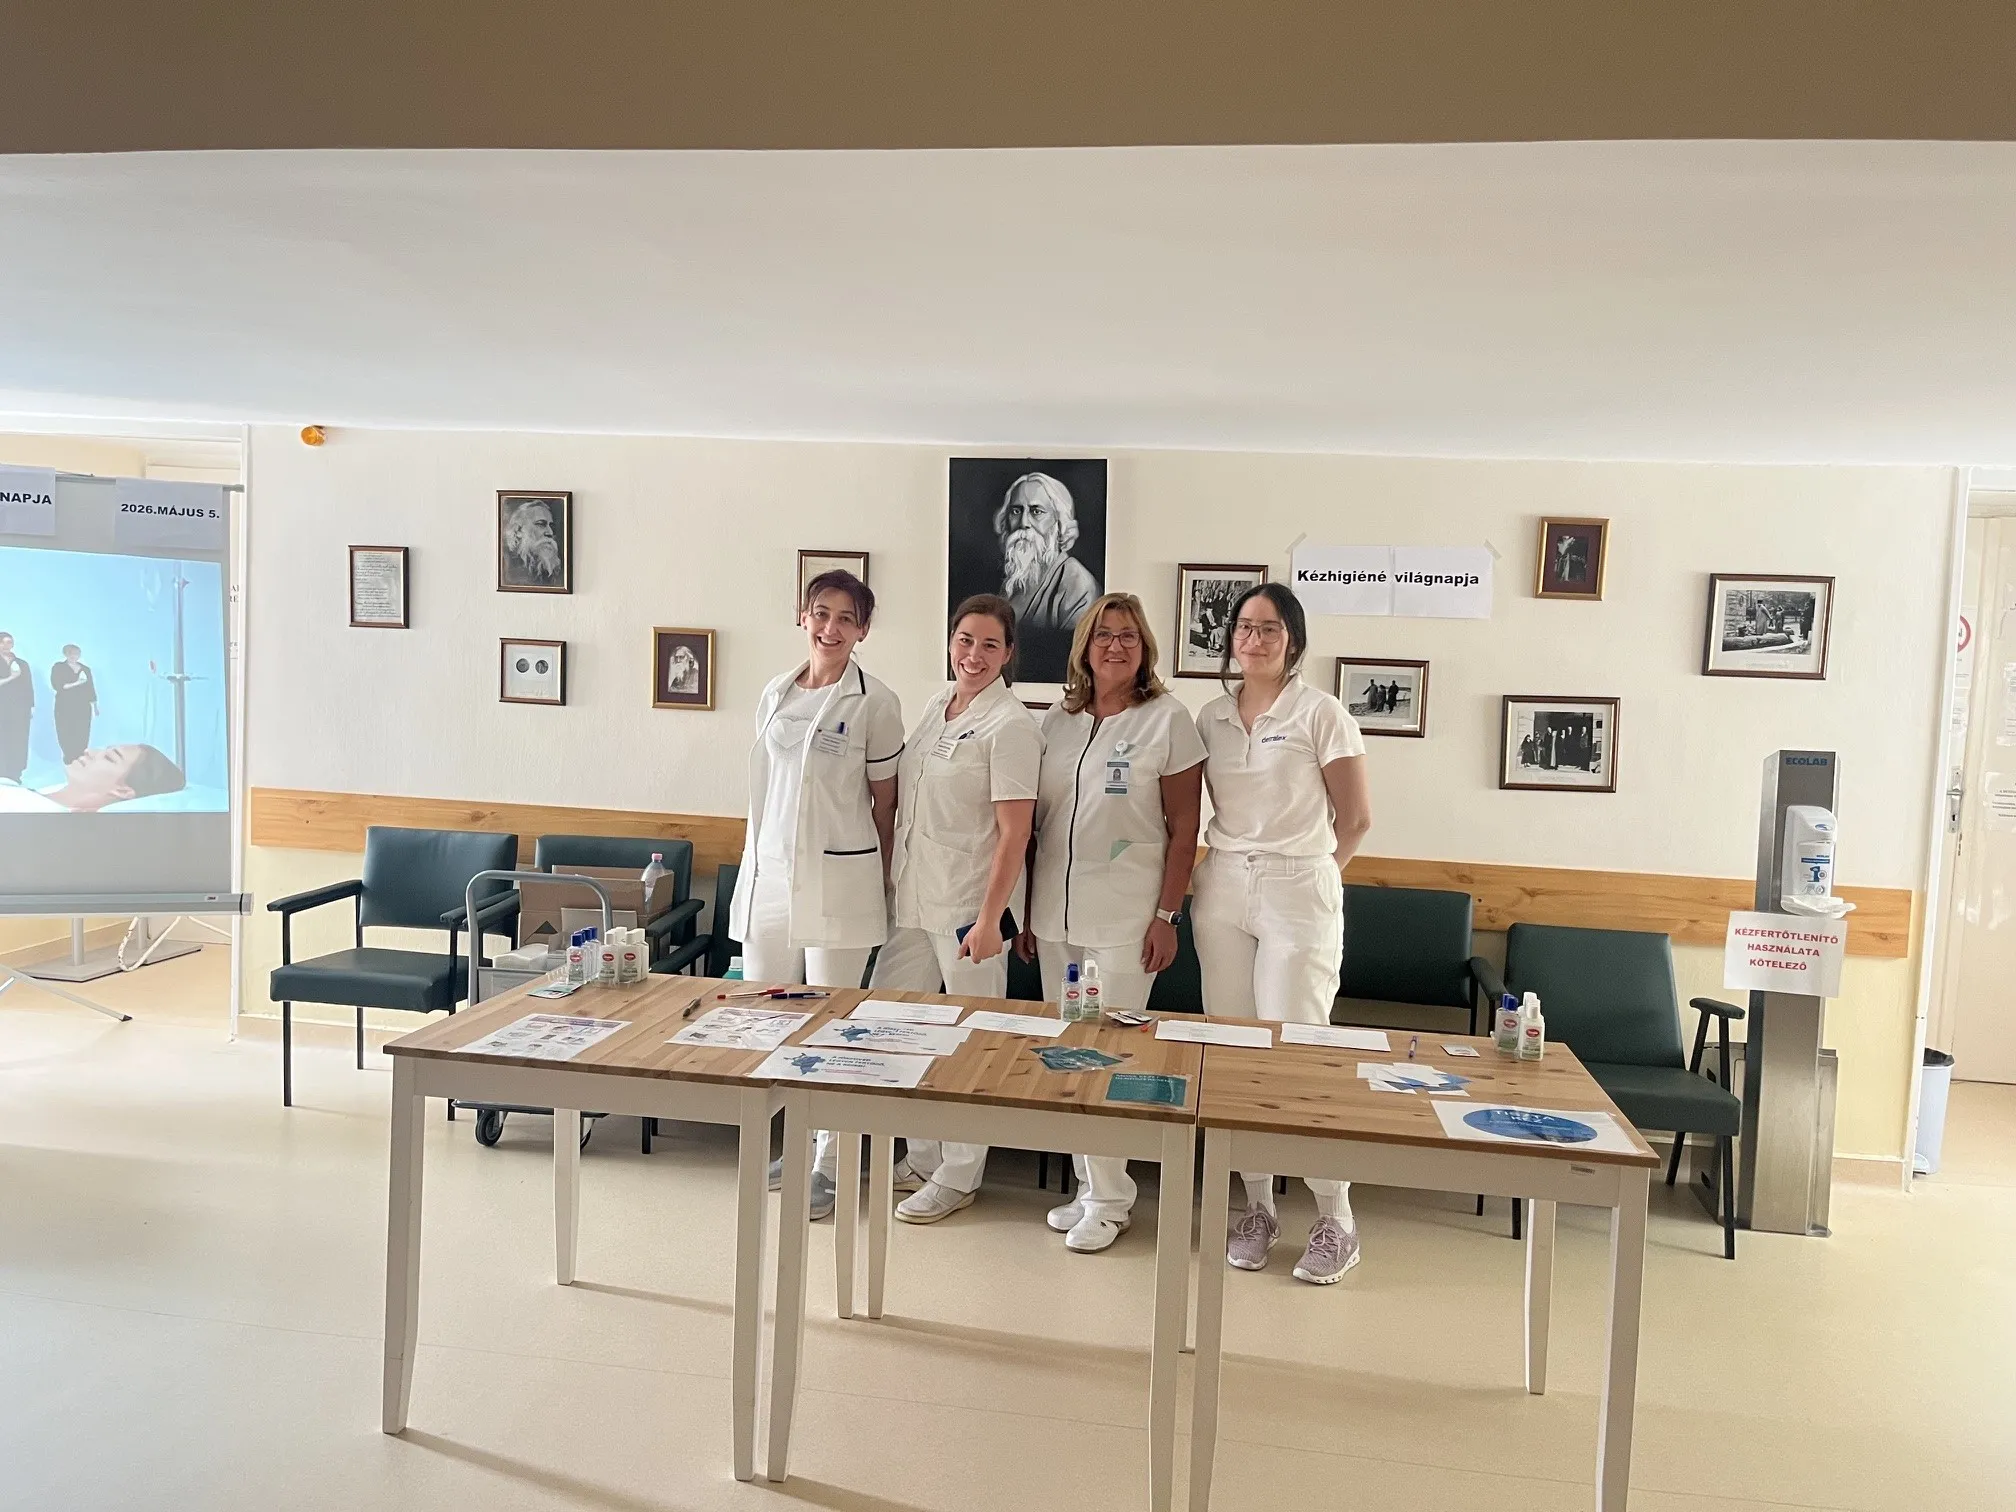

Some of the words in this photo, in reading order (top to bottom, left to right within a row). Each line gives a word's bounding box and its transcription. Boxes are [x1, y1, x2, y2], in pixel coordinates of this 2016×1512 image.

[0, 492, 52, 505] NAPJA
[121, 503, 204, 518] 2026.MÁJUS
[208, 509, 220, 519] 5.
[1297, 570, 1387, 584] Kézhigiéné
[1394, 571, 1479, 587] világnapja
[1785, 757, 1828, 766] ECOLAB
[1734, 927, 1839, 944] KÉZFERTŐTLENÍTŐ
[1747, 943, 1820, 957] HASZNÁLATA
[1749, 958, 1807, 971] KÖTELEZŐ
